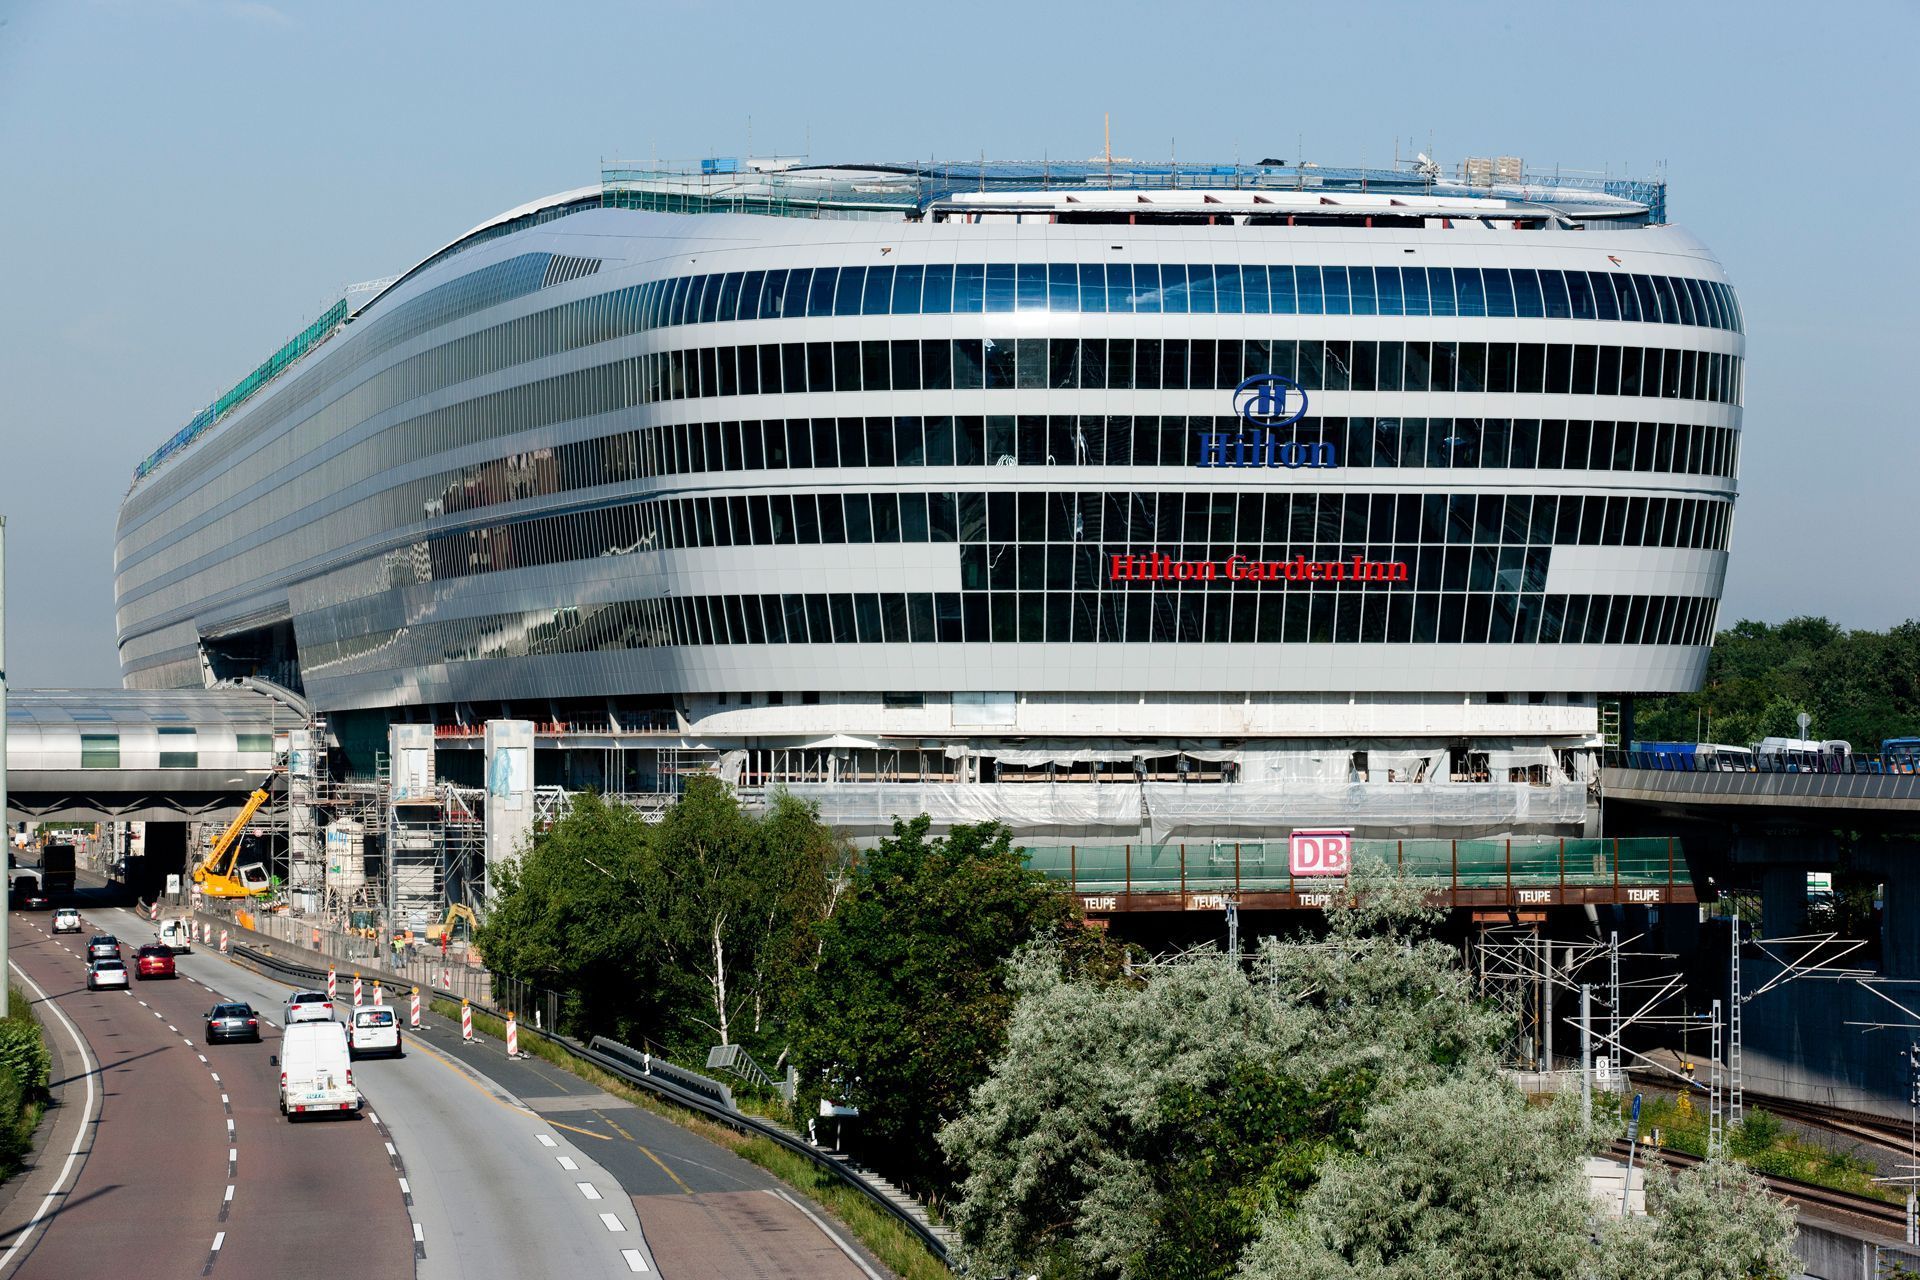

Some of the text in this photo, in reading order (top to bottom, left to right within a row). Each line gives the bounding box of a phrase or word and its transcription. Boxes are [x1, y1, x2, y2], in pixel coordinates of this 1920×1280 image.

[1196, 429, 1338, 469] Hilton
[1110, 552, 1408, 582] Hilton Garden Inn
[1297, 838, 1344, 868] DB
[1083, 897, 1117, 910] TEUPE
[1518, 890, 1551, 903] TEUPE
[1627, 889, 1660, 901] TEUPE
